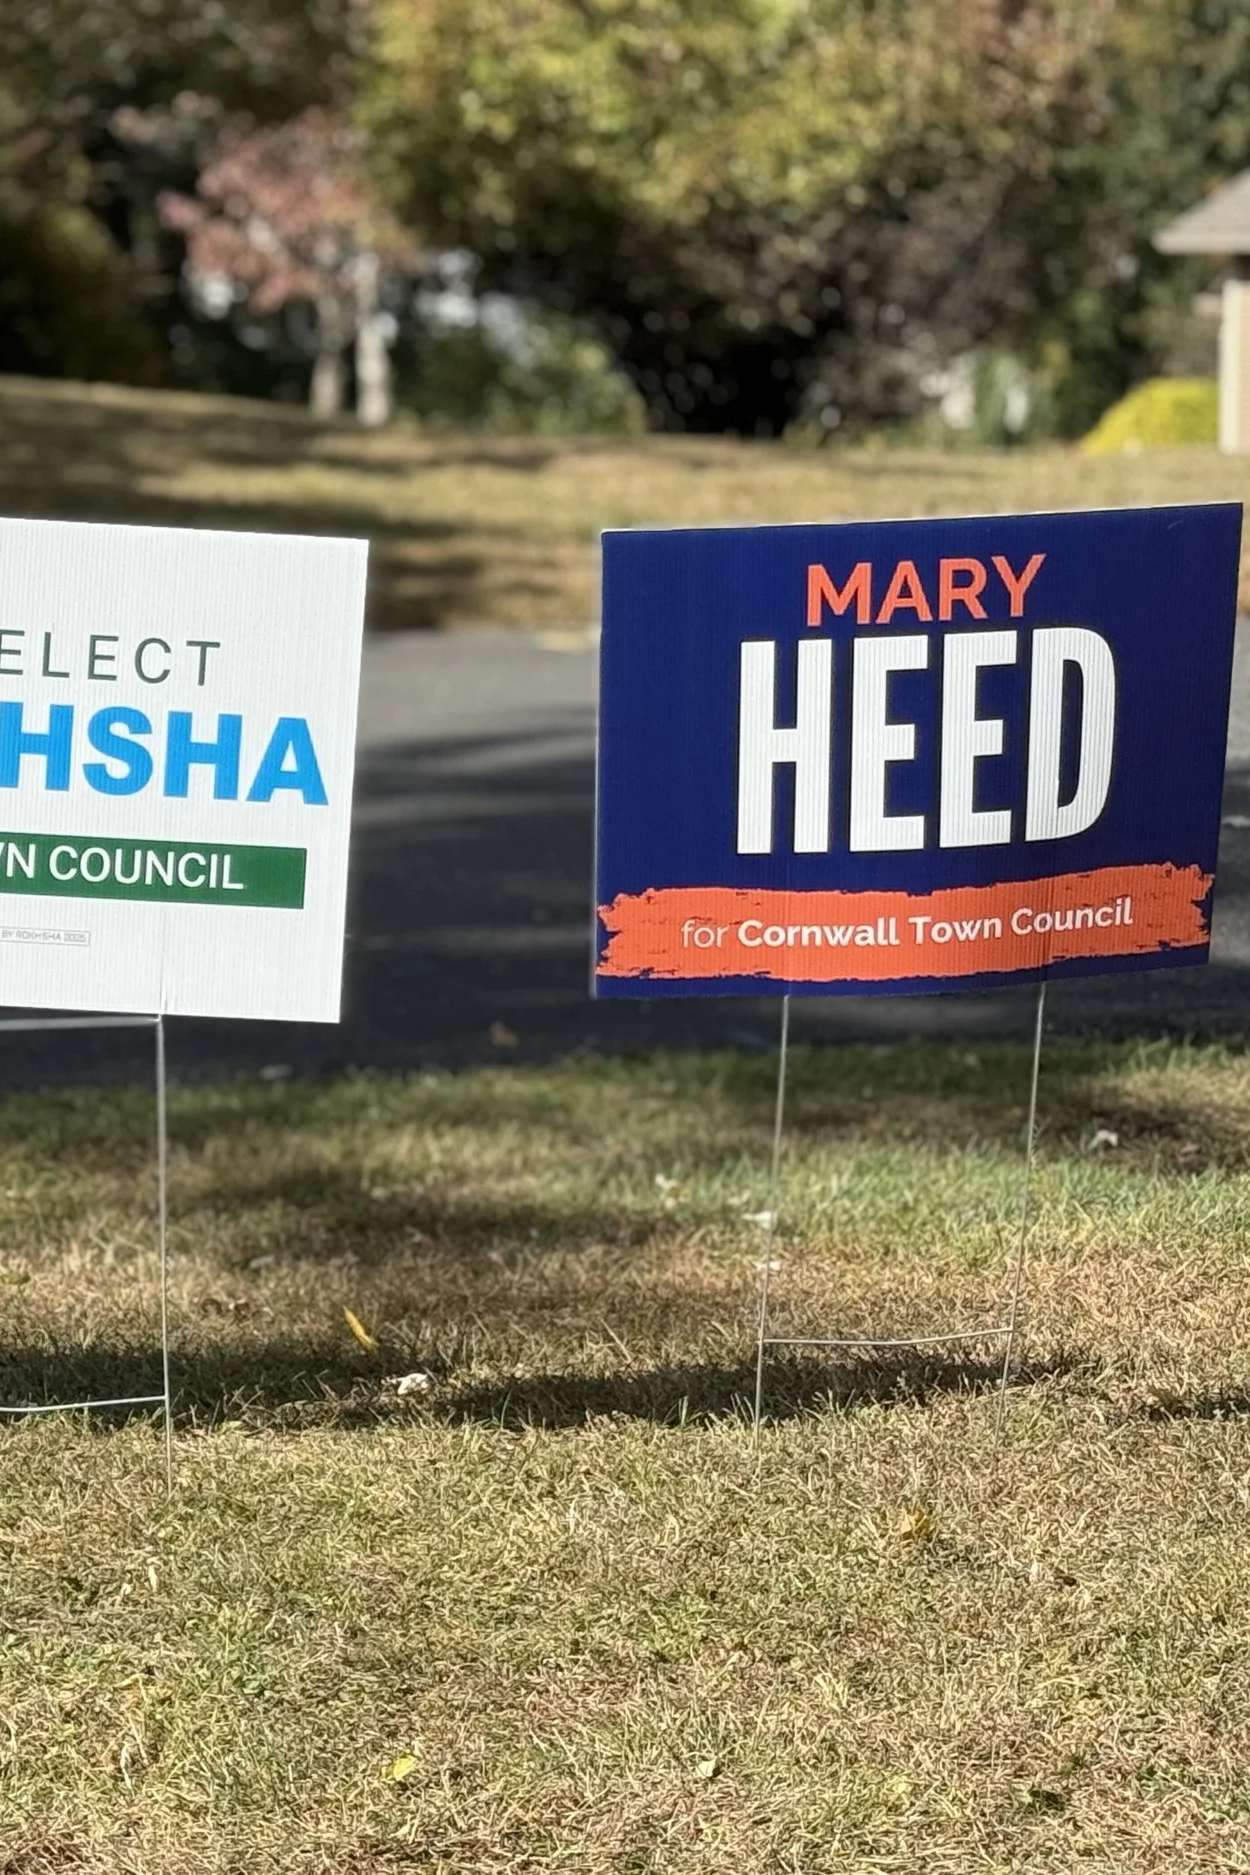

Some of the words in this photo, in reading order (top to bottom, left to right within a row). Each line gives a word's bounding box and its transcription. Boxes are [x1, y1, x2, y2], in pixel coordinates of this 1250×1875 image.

[806, 553, 1048, 627] MARY
[736, 627, 1117, 855] HEED
[49, 845, 244, 891] COUNCIL
[1, 929, 13, 939] BY
[681, 920, 730, 949] for
[737, 915, 898, 950] Cornwall
[908, 913, 1002, 945] Town
[1011, 897, 1134, 936] Council
